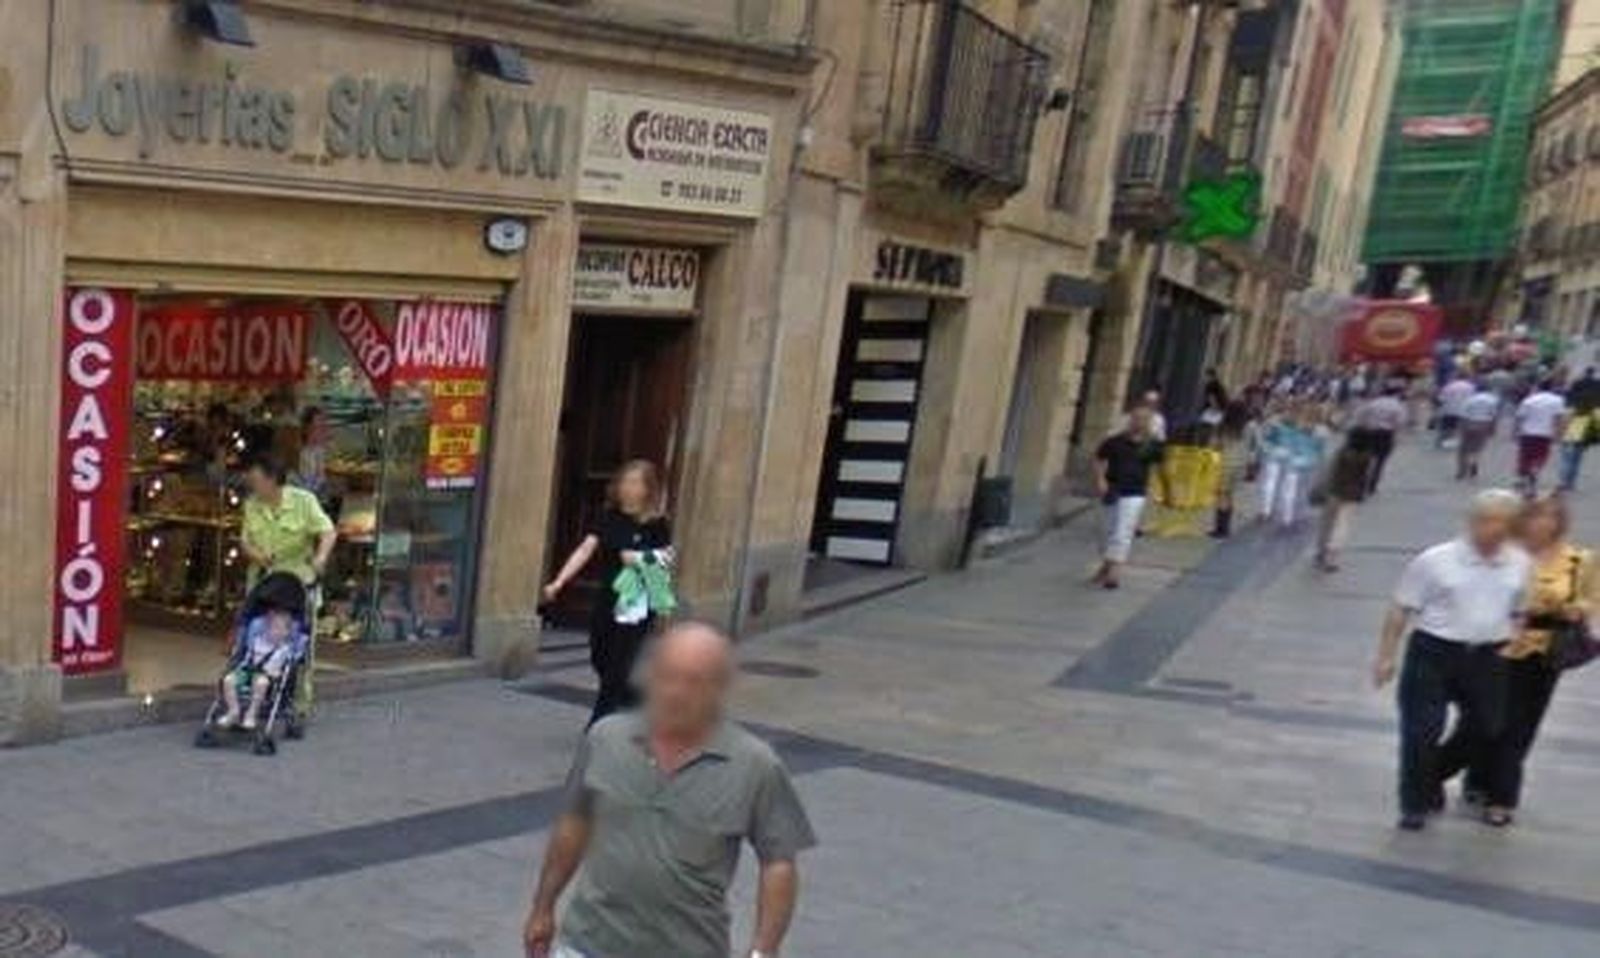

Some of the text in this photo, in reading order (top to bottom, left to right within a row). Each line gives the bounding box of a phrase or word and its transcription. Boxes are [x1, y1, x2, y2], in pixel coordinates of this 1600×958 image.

[324, 76, 472, 169] SIGLO
[475, 94, 566, 180] XXI
[650, 112, 769, 155] CIENCIA EXACTA
[628, 249, 697, 289] CALCO
[140, 312, 304, 375] OCASION
[337, 301, 392, 379] ORO
[395, 303, 490, 368] OCASION
[61, 288, 115, 649] OCASIÓN
